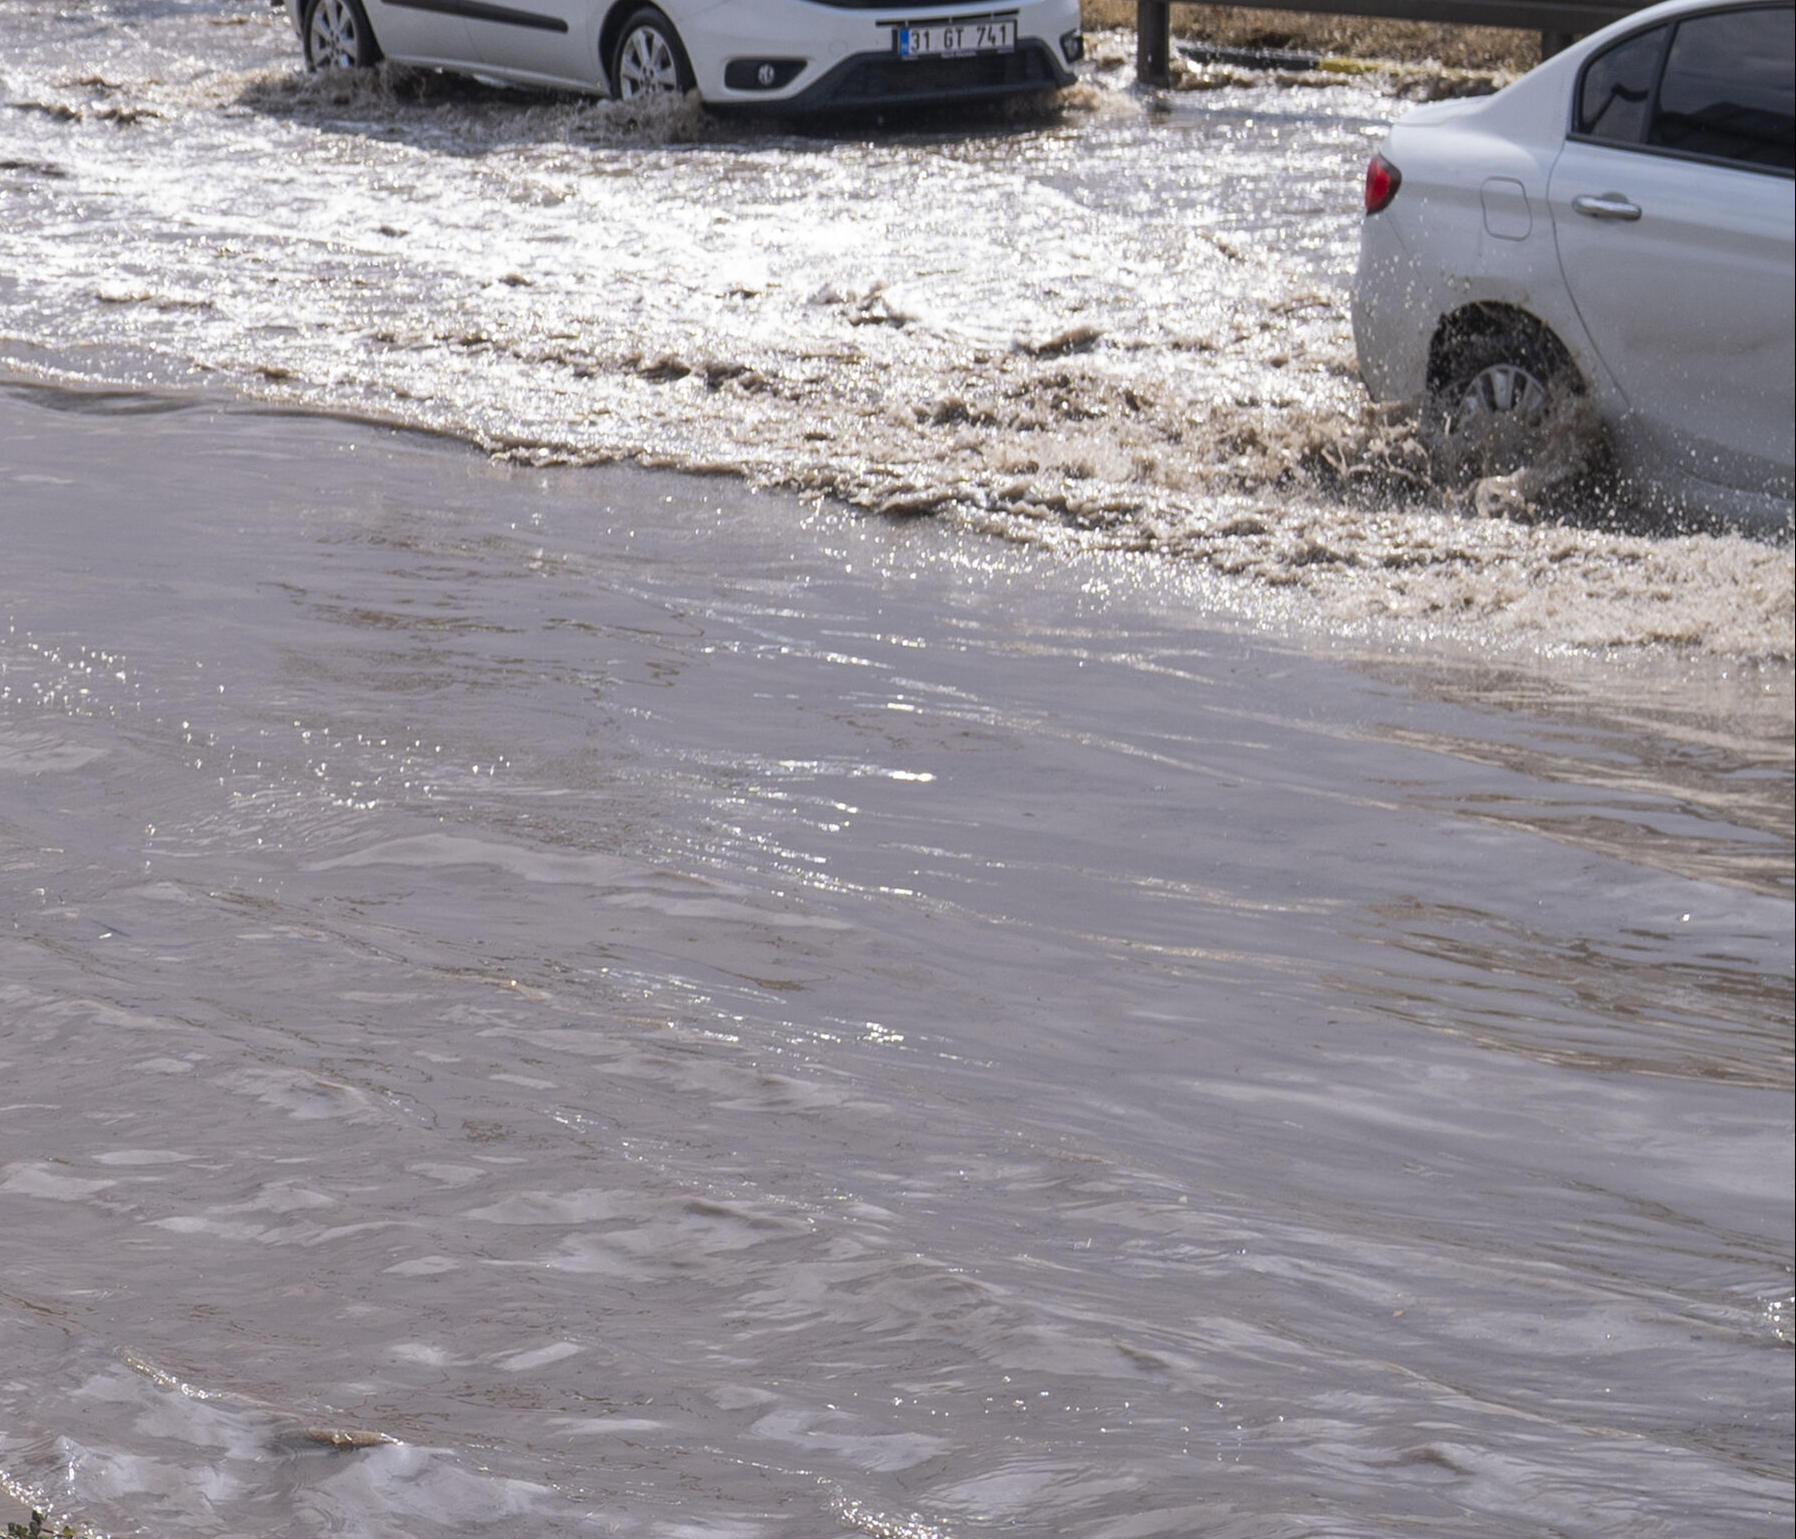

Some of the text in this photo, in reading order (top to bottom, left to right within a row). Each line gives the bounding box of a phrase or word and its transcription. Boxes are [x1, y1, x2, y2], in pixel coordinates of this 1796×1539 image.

[911, 24, 1007, 52] 31 GT 741
